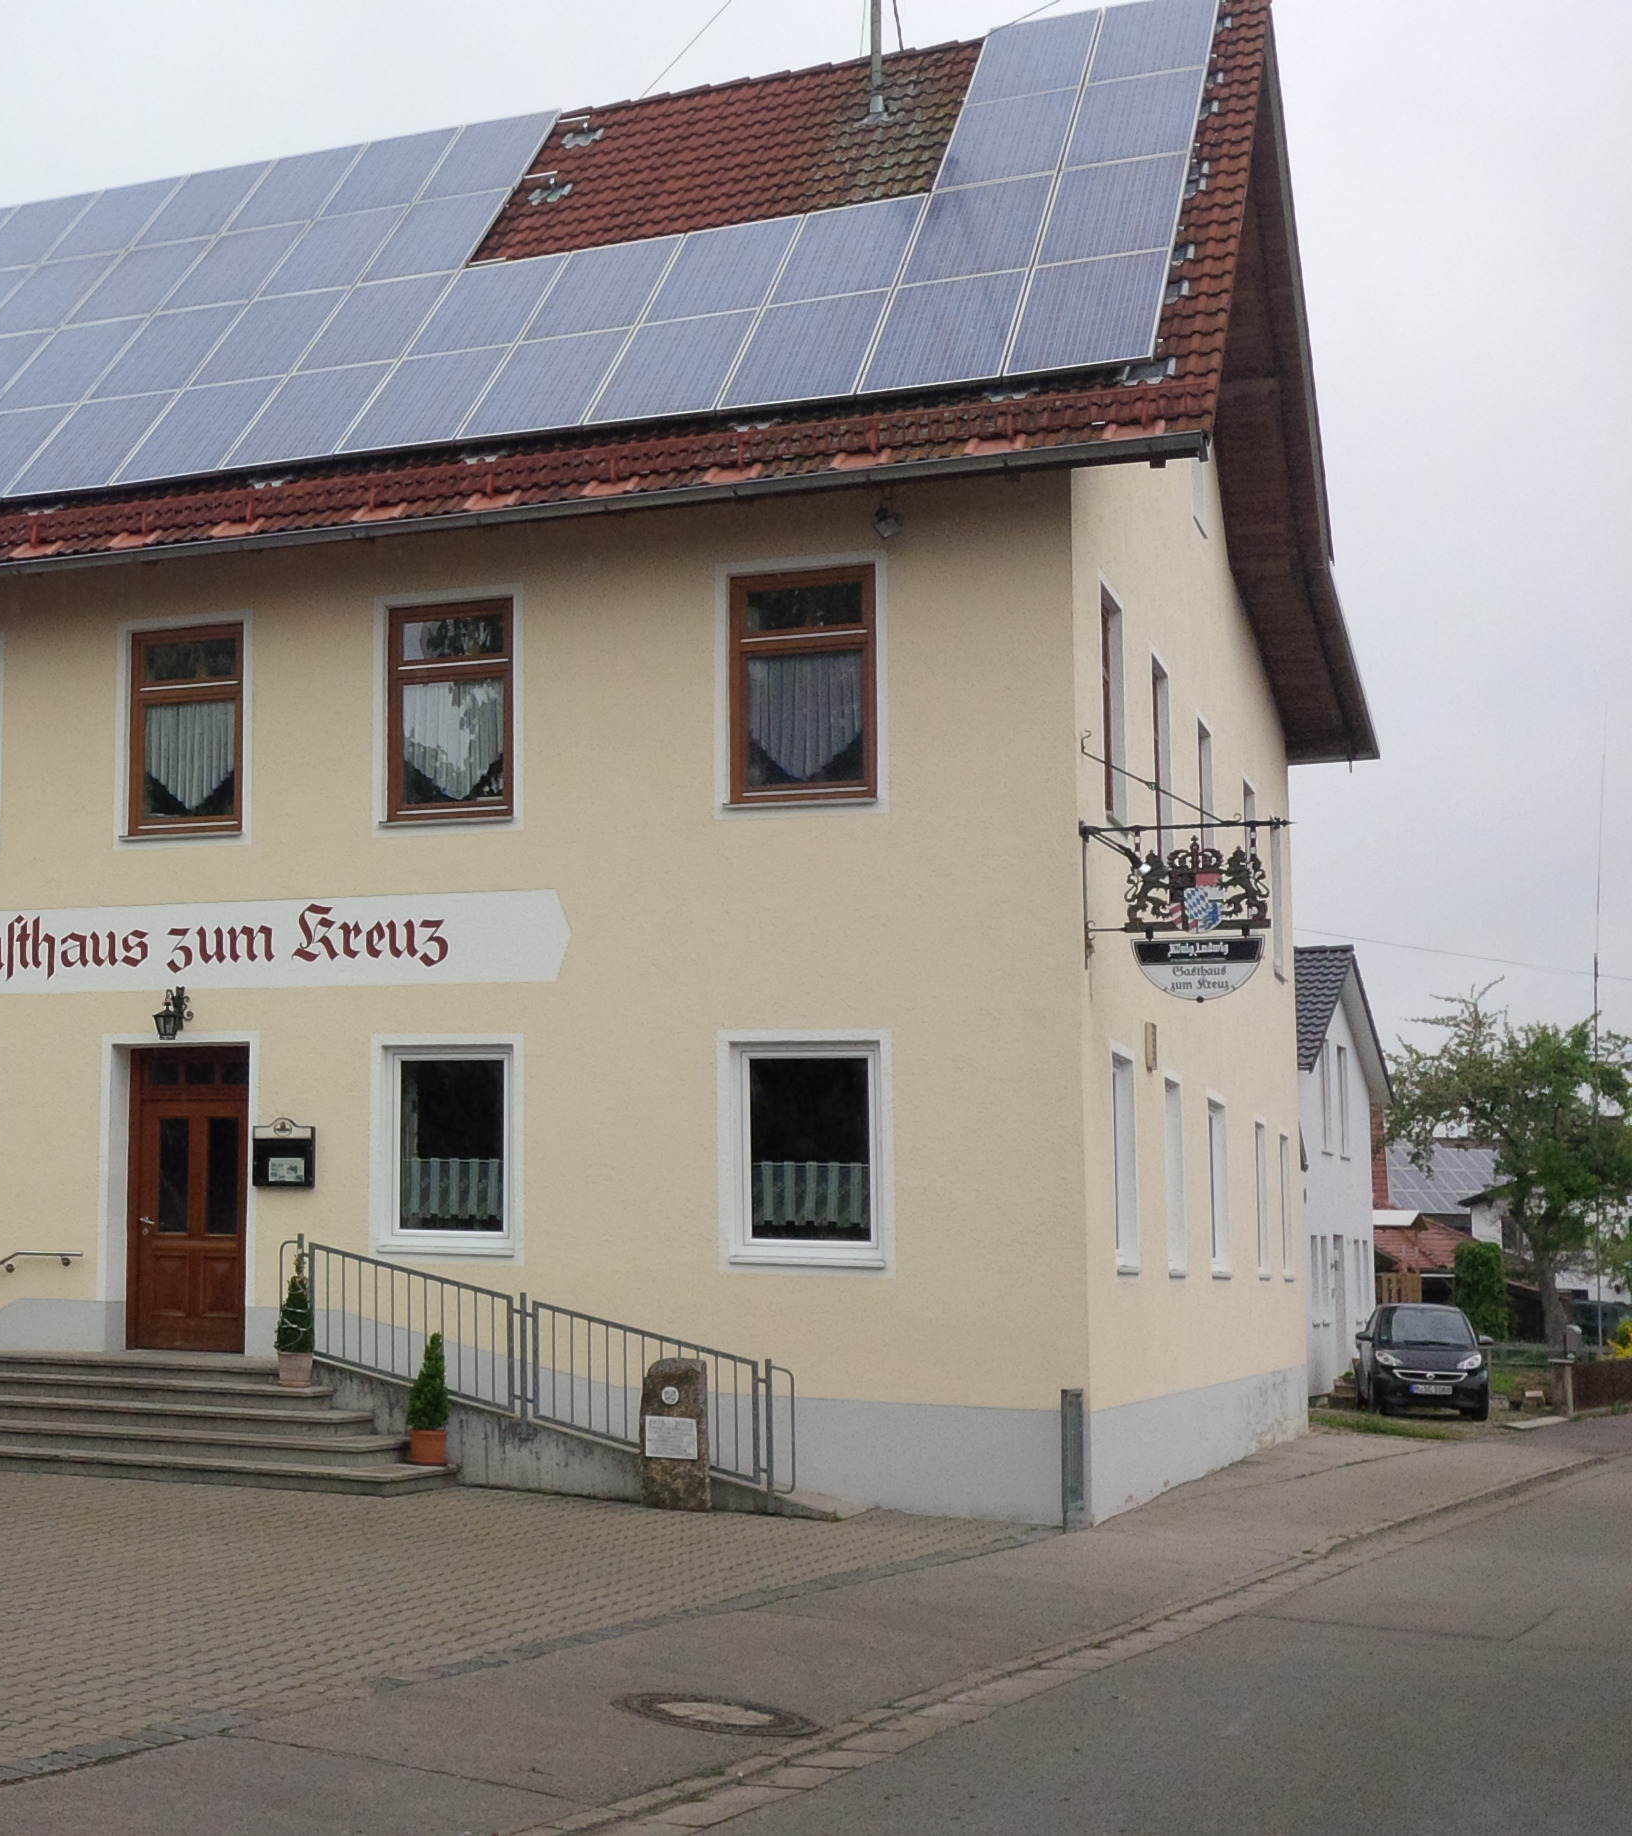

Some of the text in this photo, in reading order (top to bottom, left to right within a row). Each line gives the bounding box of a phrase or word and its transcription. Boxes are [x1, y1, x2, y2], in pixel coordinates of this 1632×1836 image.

[166, 924, 275, 974] zum
[291, 903, 449, 968] Kreuz
[1172, 965, 1227, 977] Gasthaus
[1170, 978, 1230, 992] zum Kreuz
